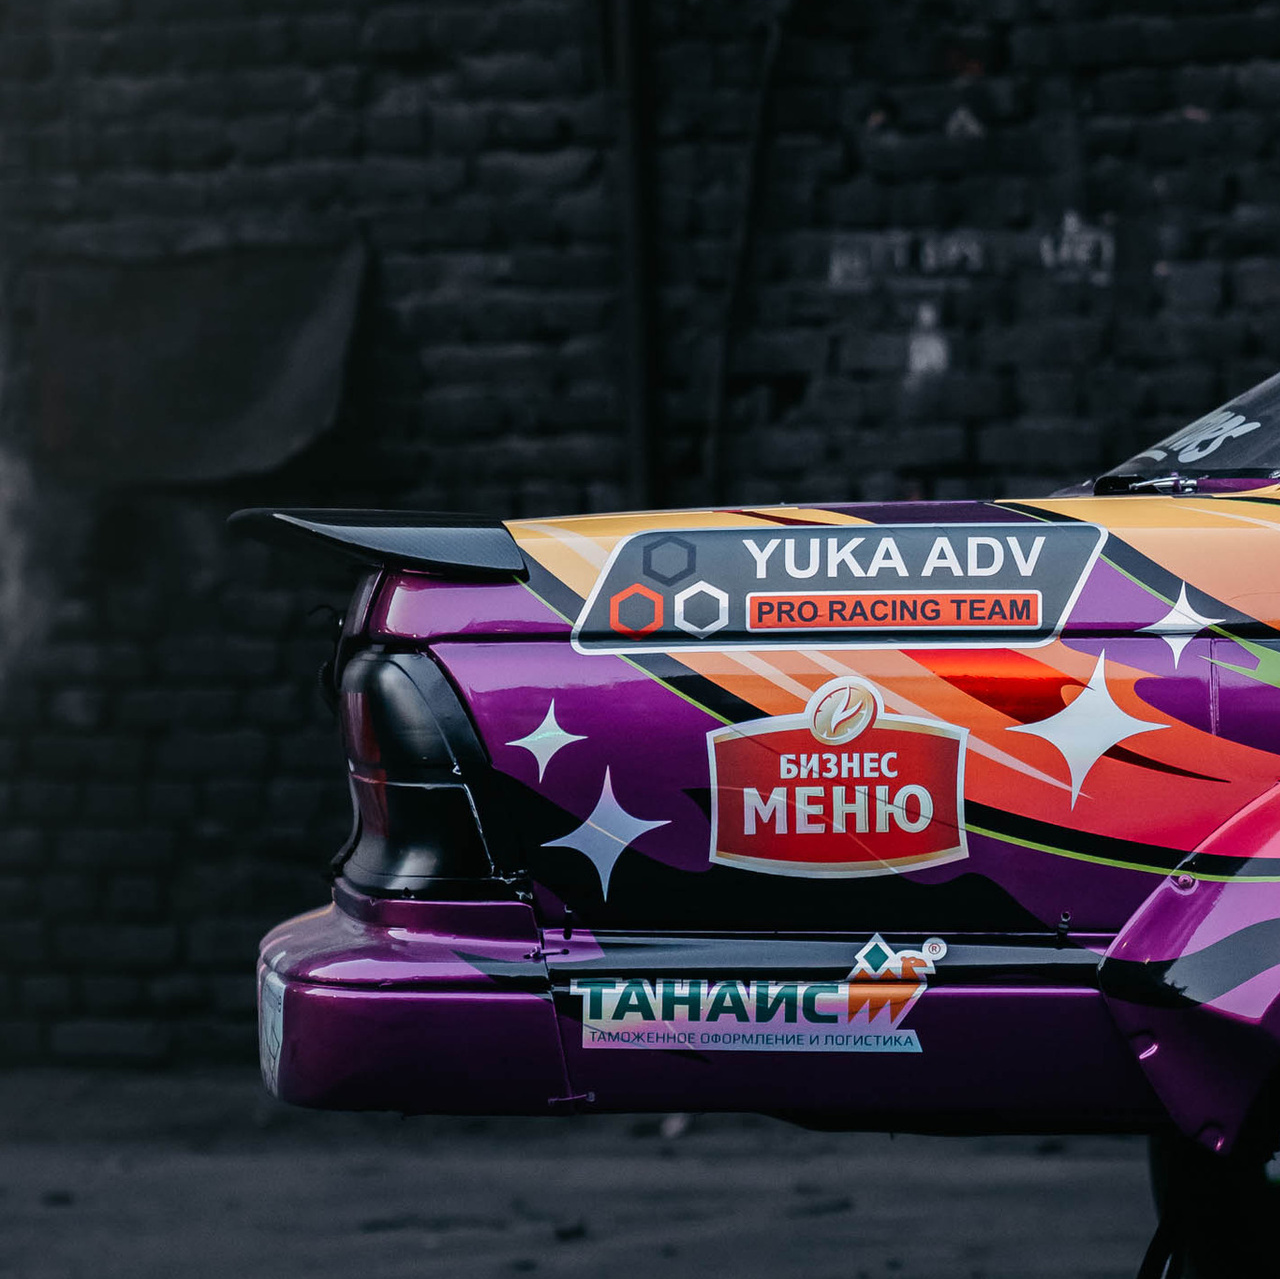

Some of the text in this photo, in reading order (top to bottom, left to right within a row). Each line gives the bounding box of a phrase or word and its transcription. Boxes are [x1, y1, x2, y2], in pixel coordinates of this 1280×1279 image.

[742, 536, 1046, 579] YUKA ADV
[757, 599, 1031, 623] PRO RACING TEAM
[779, 751, 898, 779] БИЗНЕС
[743, 784, 934, 835] МЕНЮ
[576, 980, 839, 1023] ТАНАИС
[589, 1030, 914, 1047] ТАМОЖЕННОЕ ОФОРМЛЕНИЕ И ЛОГИСТИКА
